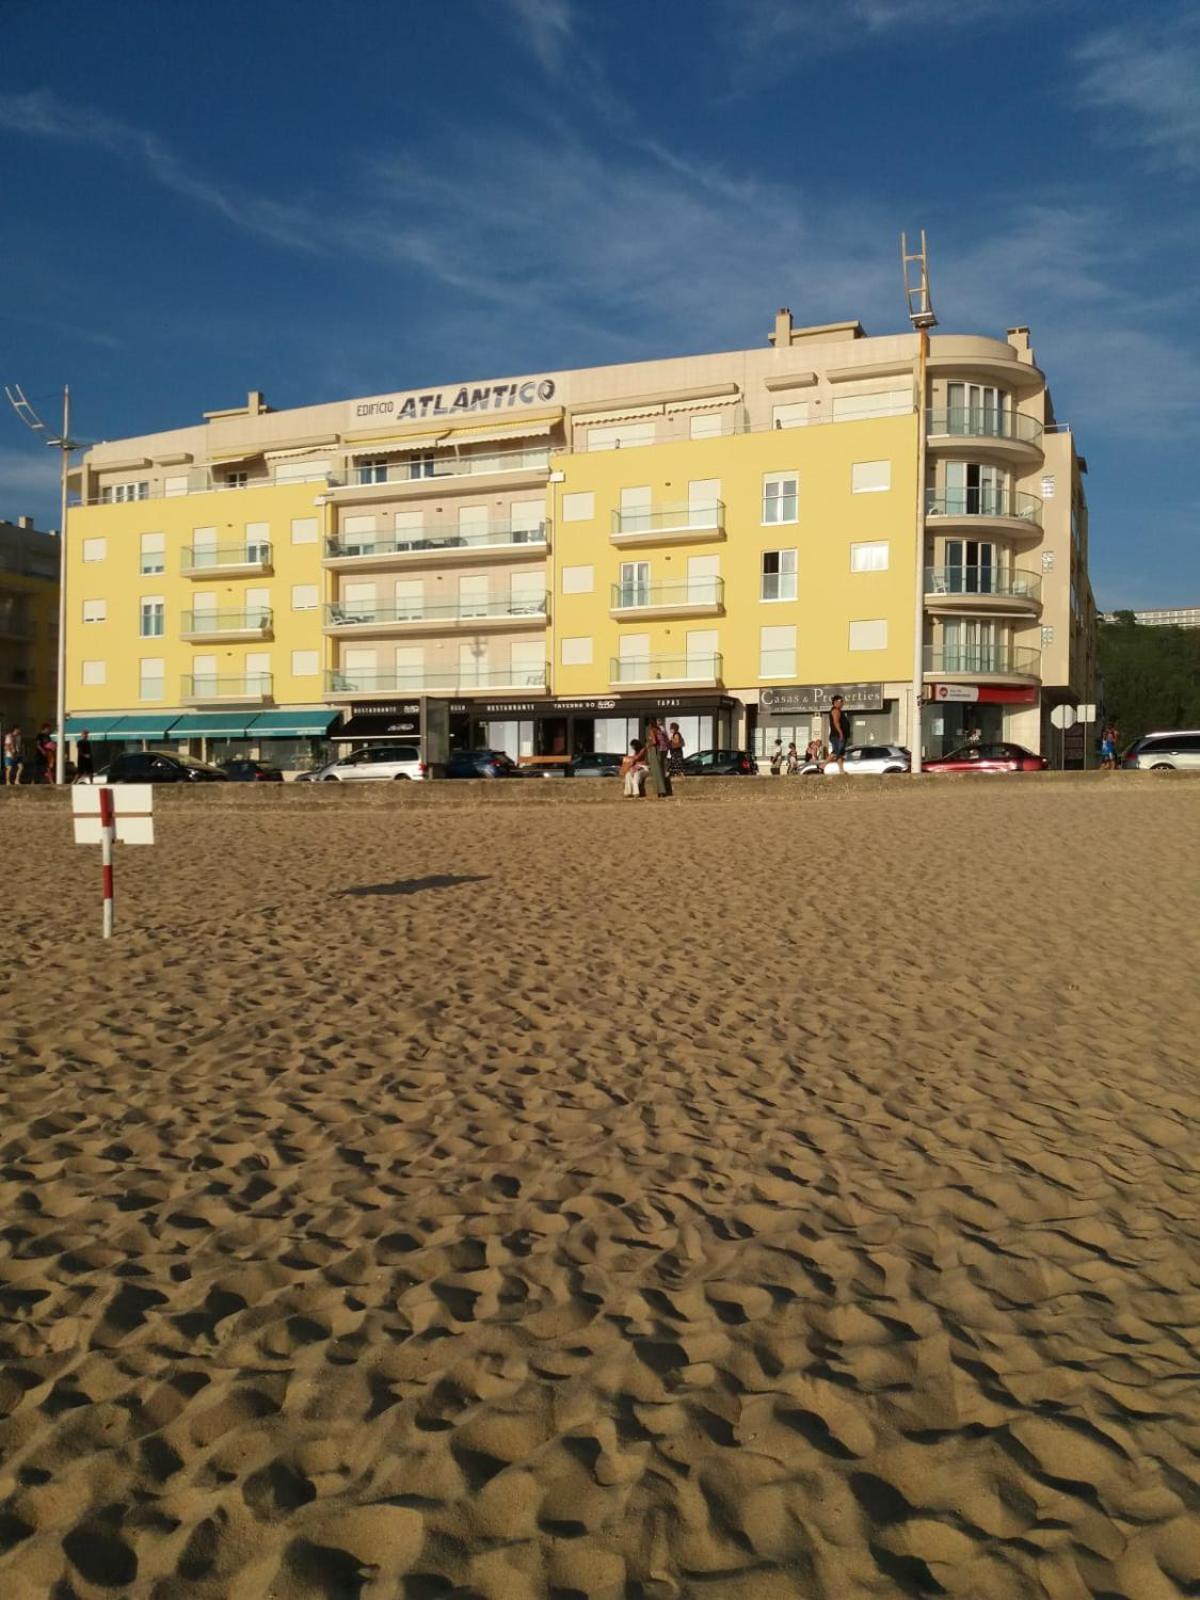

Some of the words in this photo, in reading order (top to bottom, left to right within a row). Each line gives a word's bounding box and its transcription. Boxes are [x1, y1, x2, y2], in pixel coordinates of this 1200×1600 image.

[356, 401, 394, 417] EDIFÍCIO
[397, 379, 555, 420] ATLÂNTICO
[760, 690, 800, 705] Casas
[814, 688, 880, 703] Proerties
